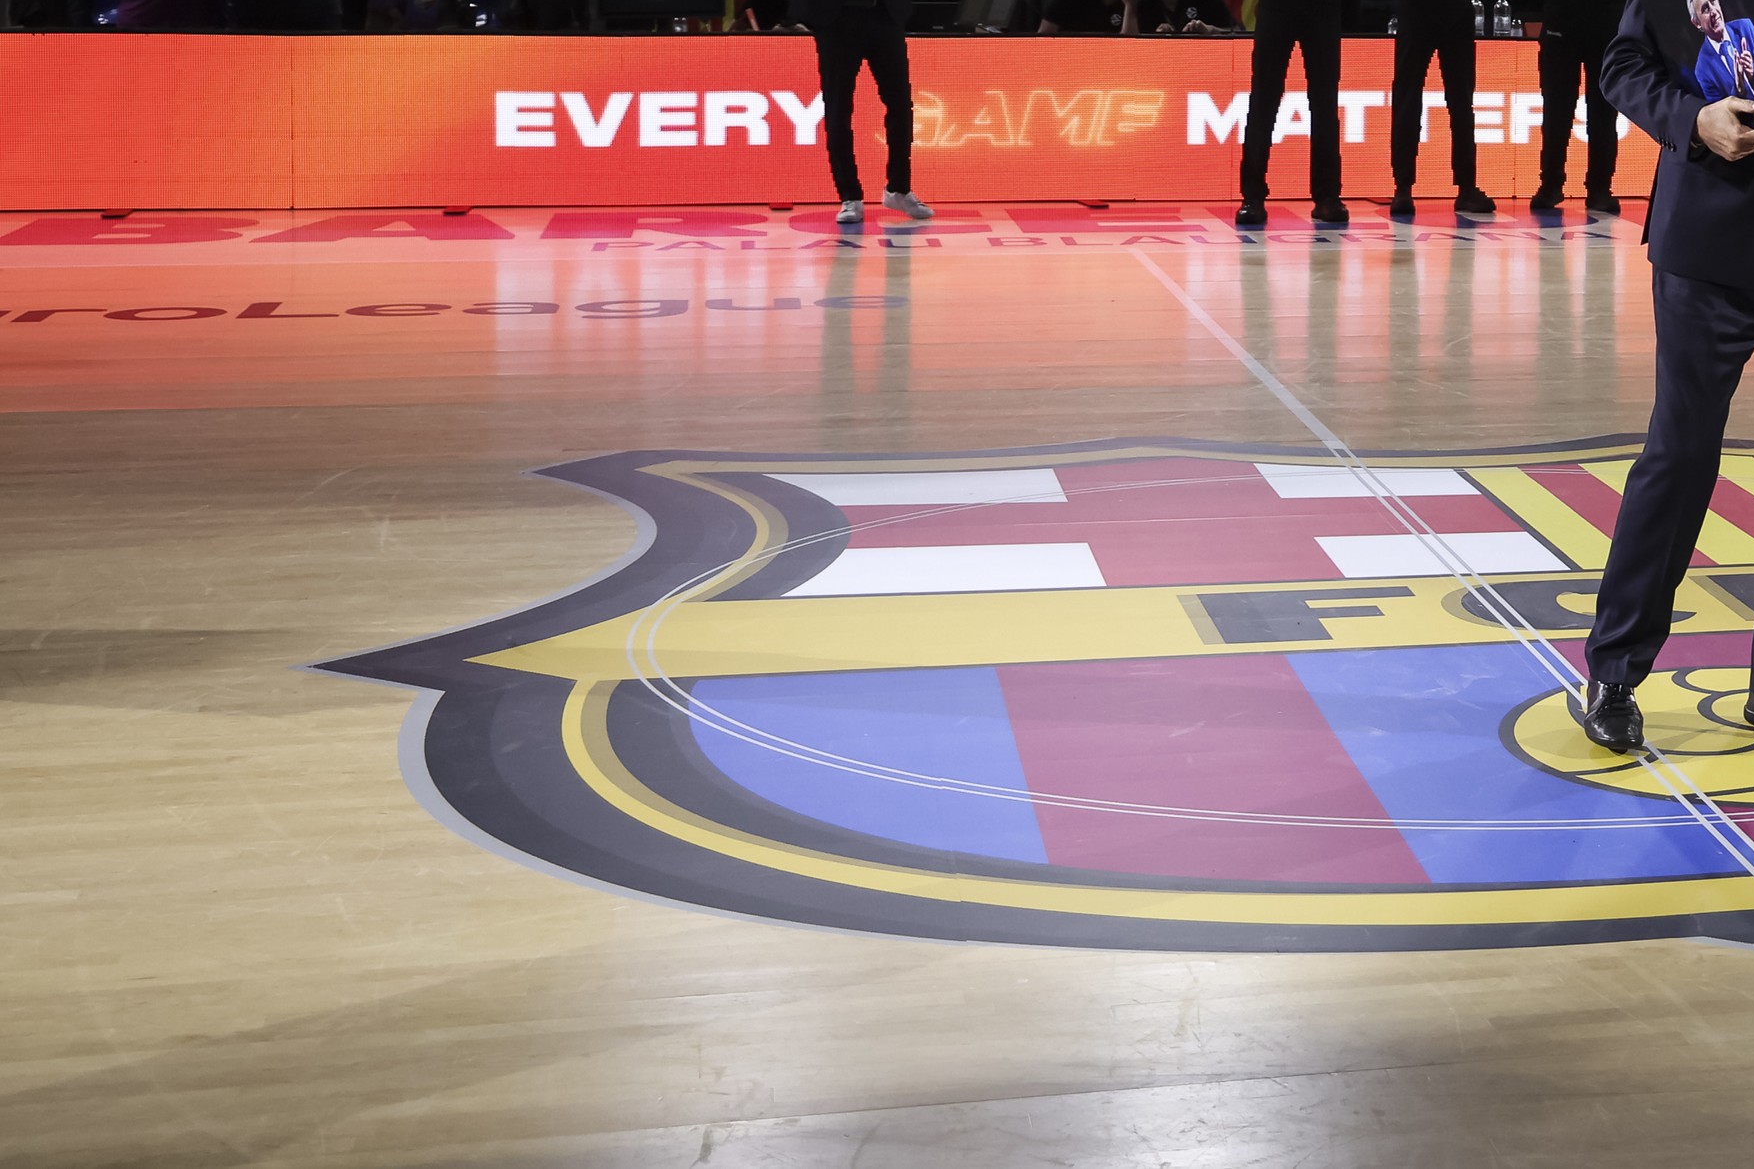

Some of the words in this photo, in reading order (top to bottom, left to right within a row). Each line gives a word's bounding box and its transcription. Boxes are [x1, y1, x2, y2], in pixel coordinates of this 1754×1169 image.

[495, 90, 826, 149] EVERY
[591, 238, 943, 252] PALAU
[986, 230, 1621, 248] BLAUGRANA
[0, 295, 909, 323] roLeague
